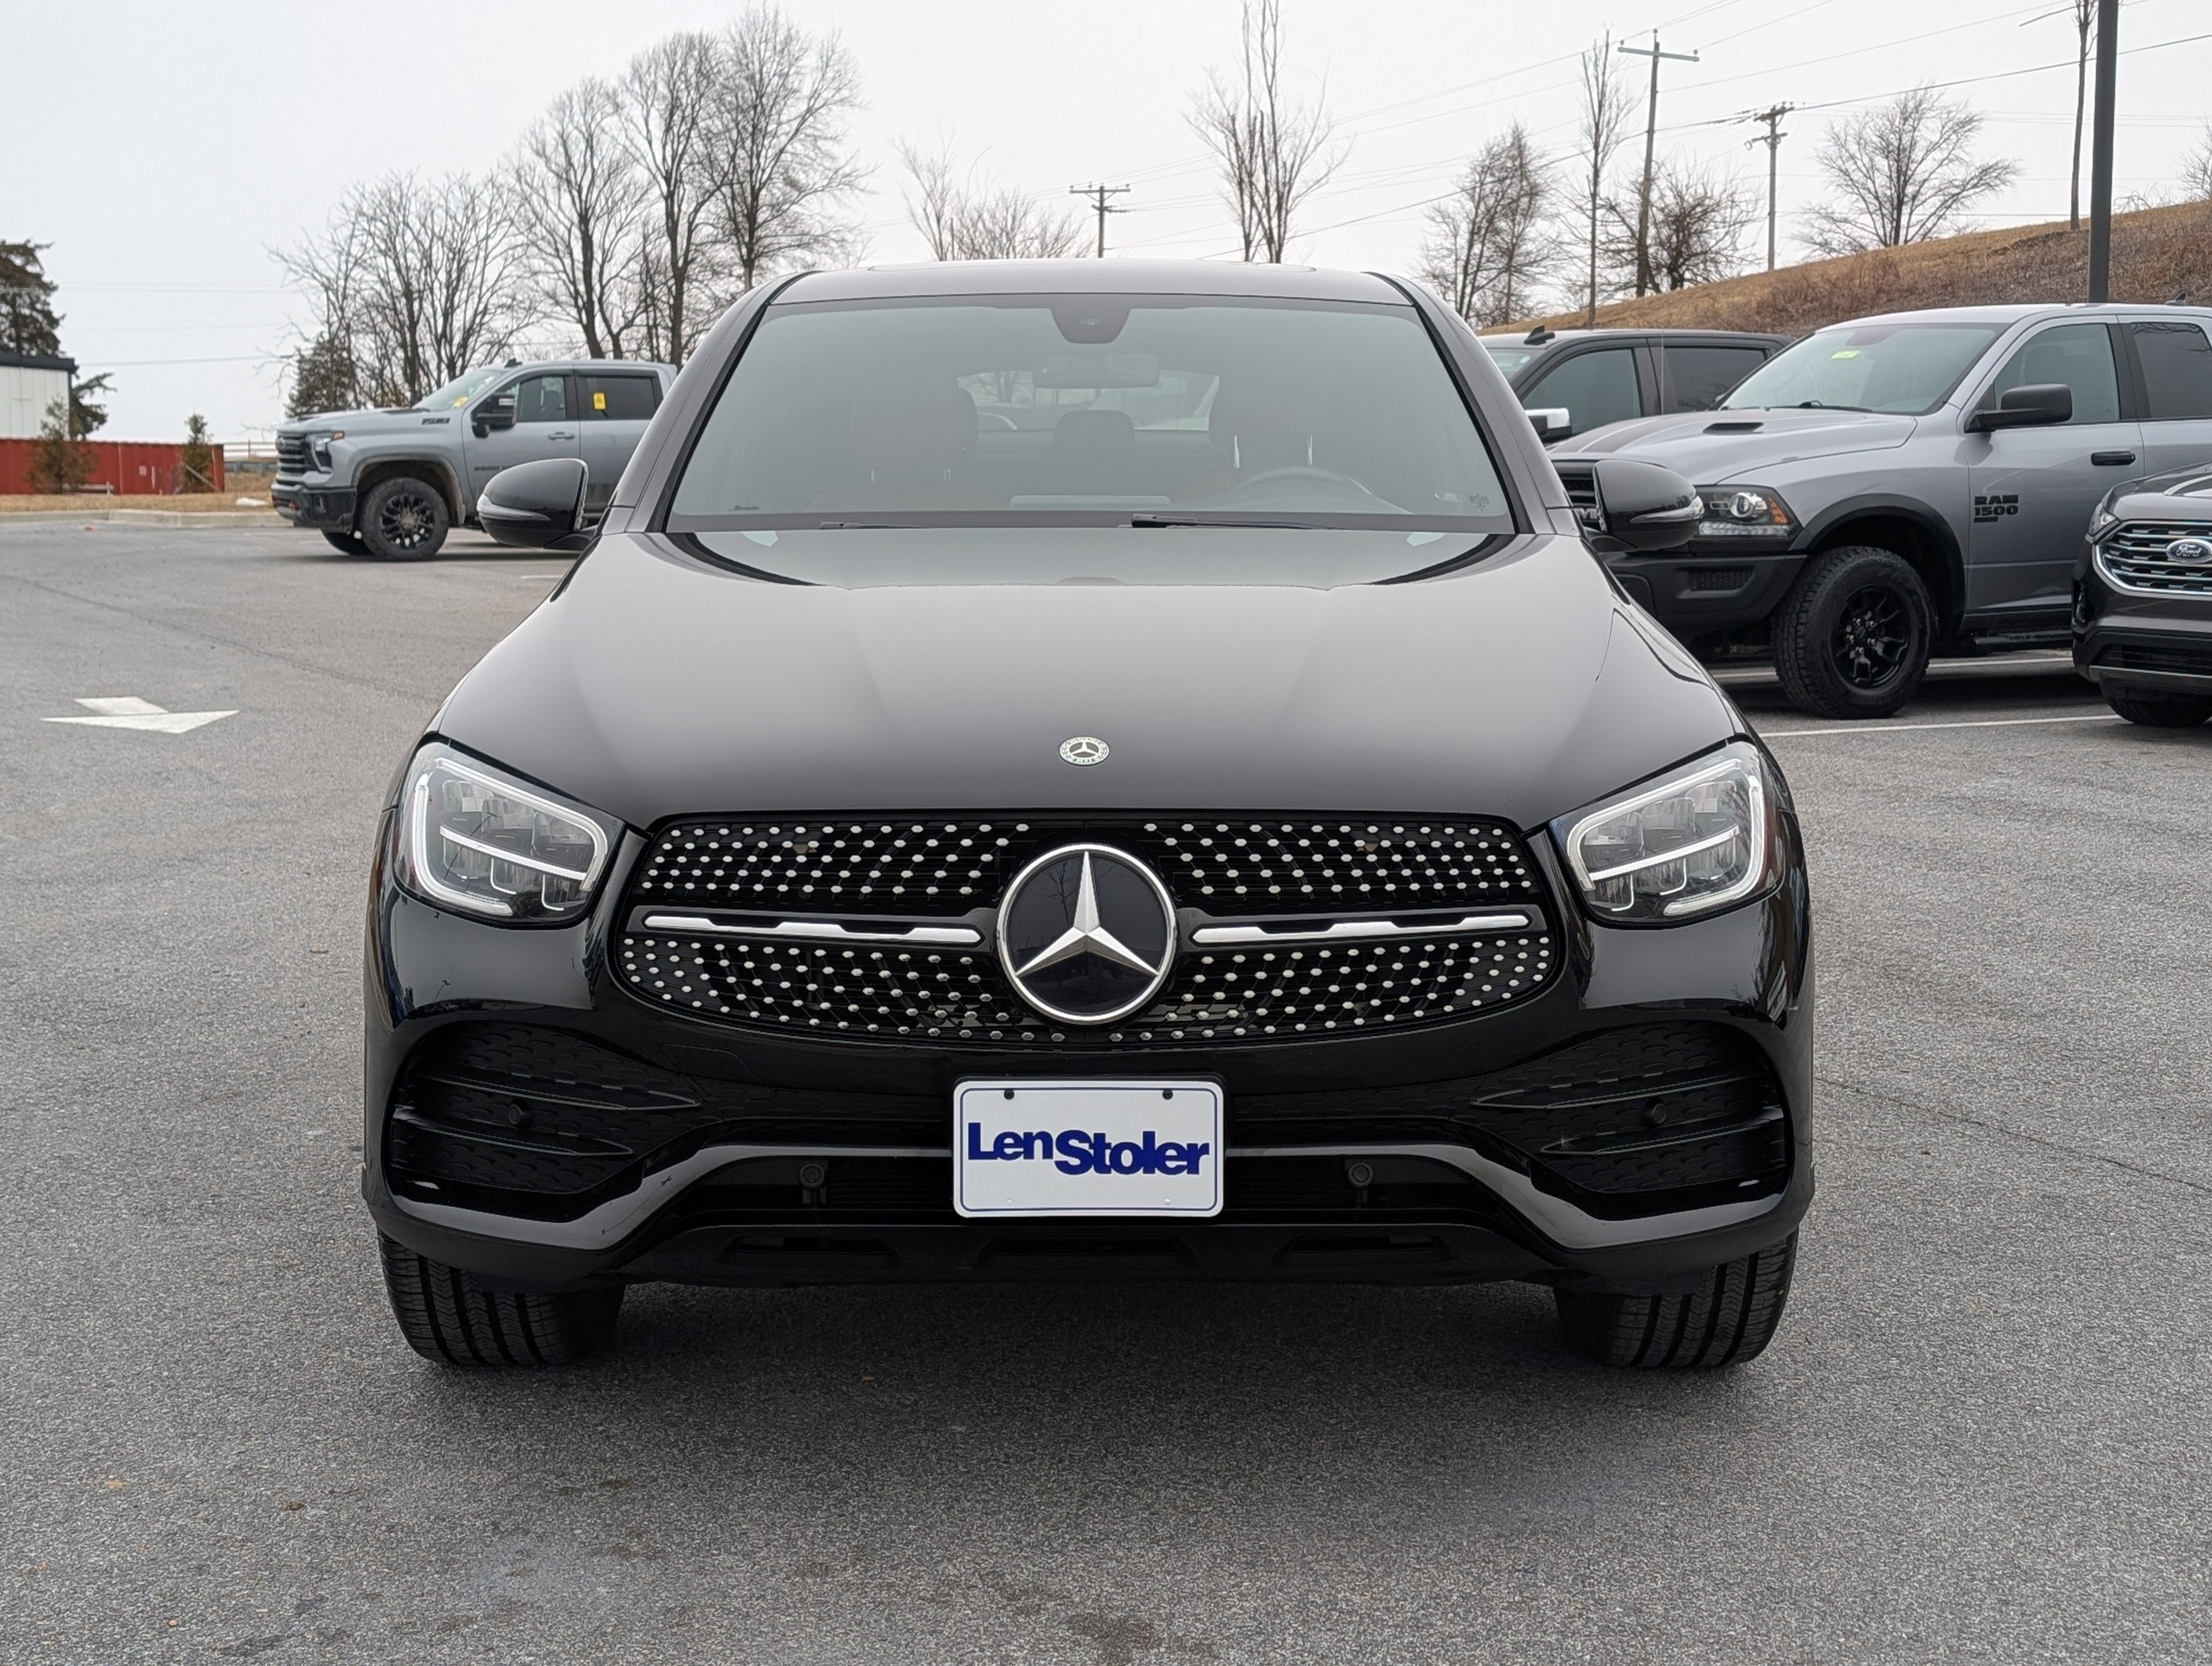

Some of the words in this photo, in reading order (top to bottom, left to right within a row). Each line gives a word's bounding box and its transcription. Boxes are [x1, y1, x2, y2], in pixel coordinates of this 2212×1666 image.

[1975, 495, 2018, 505] RAM
[1975, 505, 2018, 516] 1500
[2176, 544, 2202, 557] Ford
